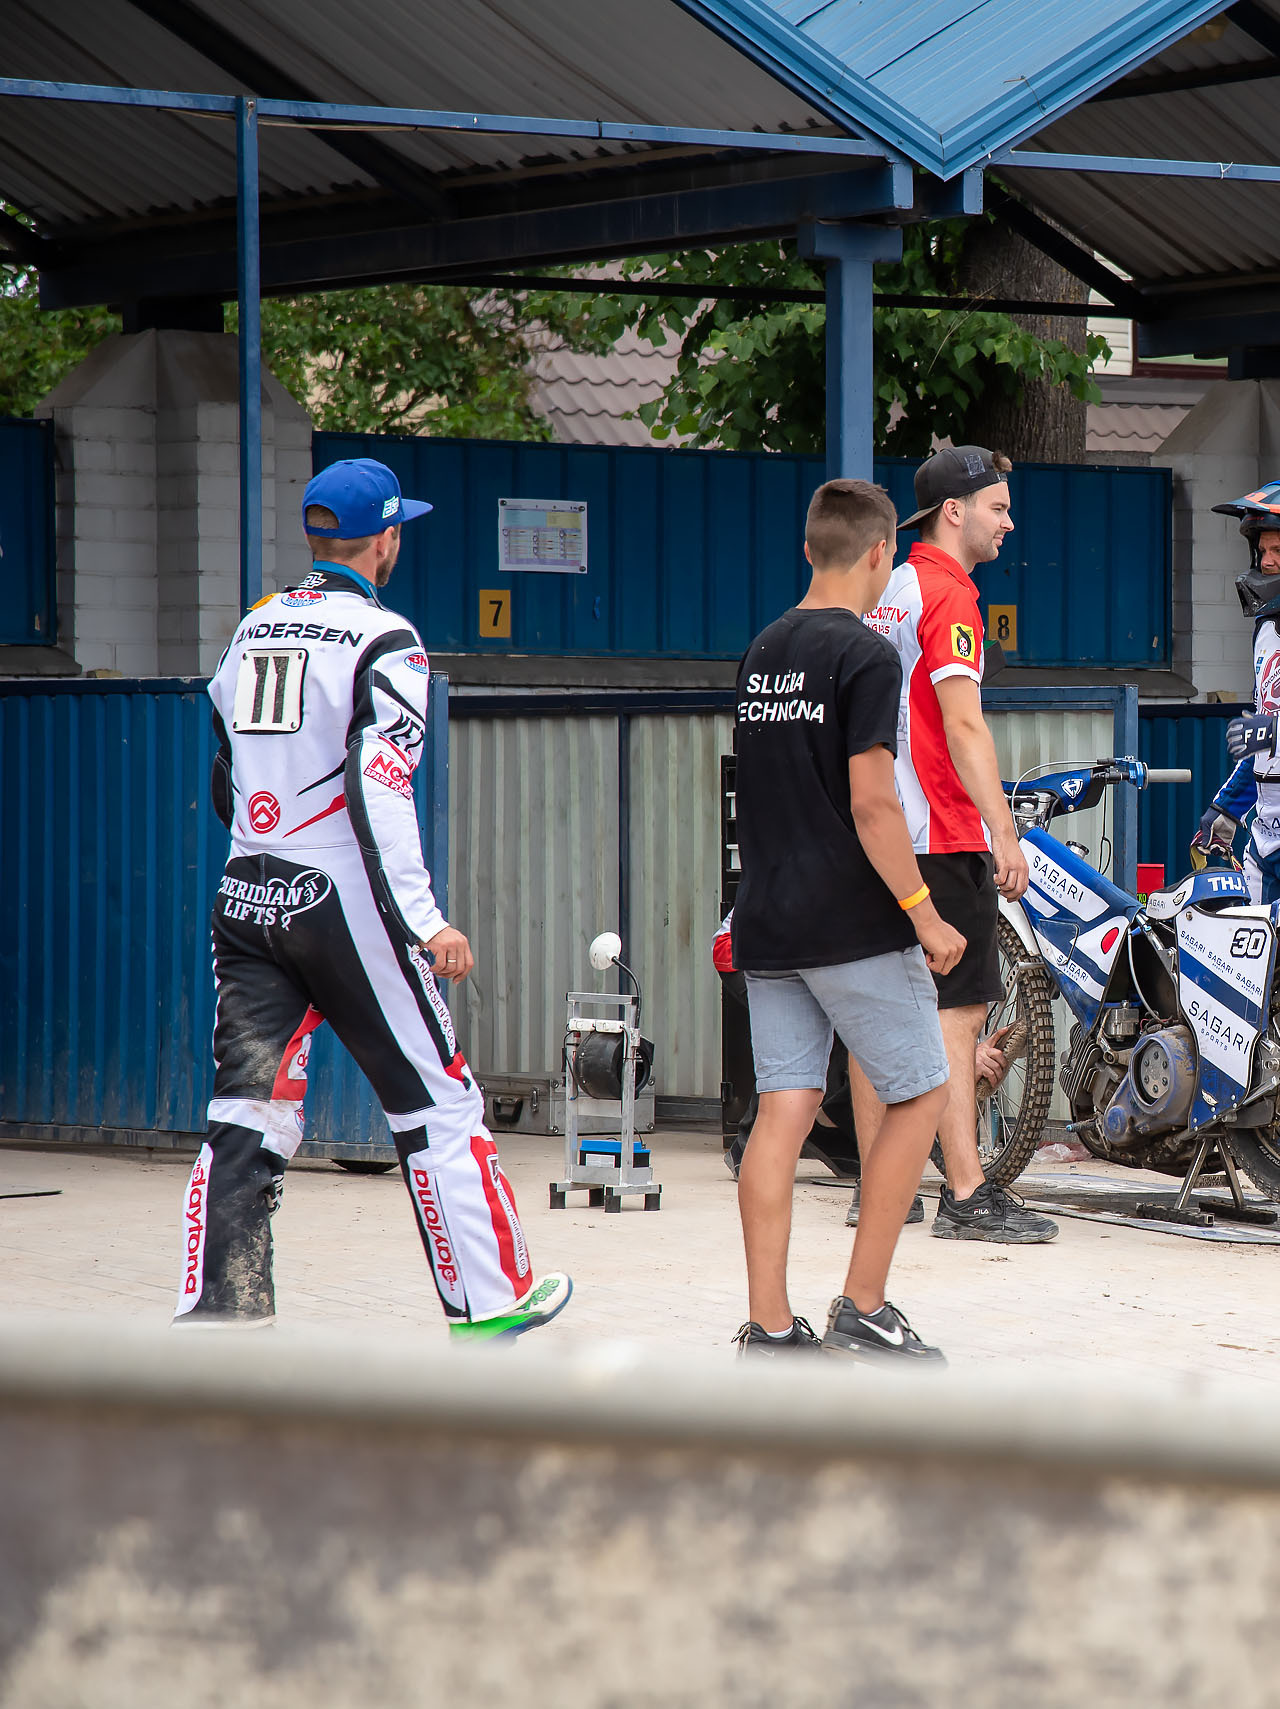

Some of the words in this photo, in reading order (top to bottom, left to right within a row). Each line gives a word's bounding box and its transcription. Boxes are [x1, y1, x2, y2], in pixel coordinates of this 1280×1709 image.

[489, 600, 502, 626] 7
[997, 614, 1010, 641] 8
[234, 622, 364, 648] ANDERSEN
[250, 655, 290, 724] 11
[1244, 727, 1273, 744] FO
[365, 767, 390, 787] SPARK
[217, 876, 305, 906] MERIDIAN
[1033, 855, 1084, 903] SAGARI
[1039, 878, 1063, 899] SPORTS
[223, 898, 278, 926] LIFTS
[1149, 898, 1167, 909] AGARI
[1230, 928, 1268, 960] 30
[1180, 930, 1206, 954] SAGARI
[1207, 951, 1234, 975] SAGARI
[1235, 973, 1263, 997] SAGARI
[412, 957, 448, 1019] ANDERSEN
[1188, 1000, 1250, 1055] SAGARI
[1200, 1029, 1228, 1051] SPORTS
[185, 1167, 206, 1294] daytona
[413, 1168, 457, 1283] daytona
